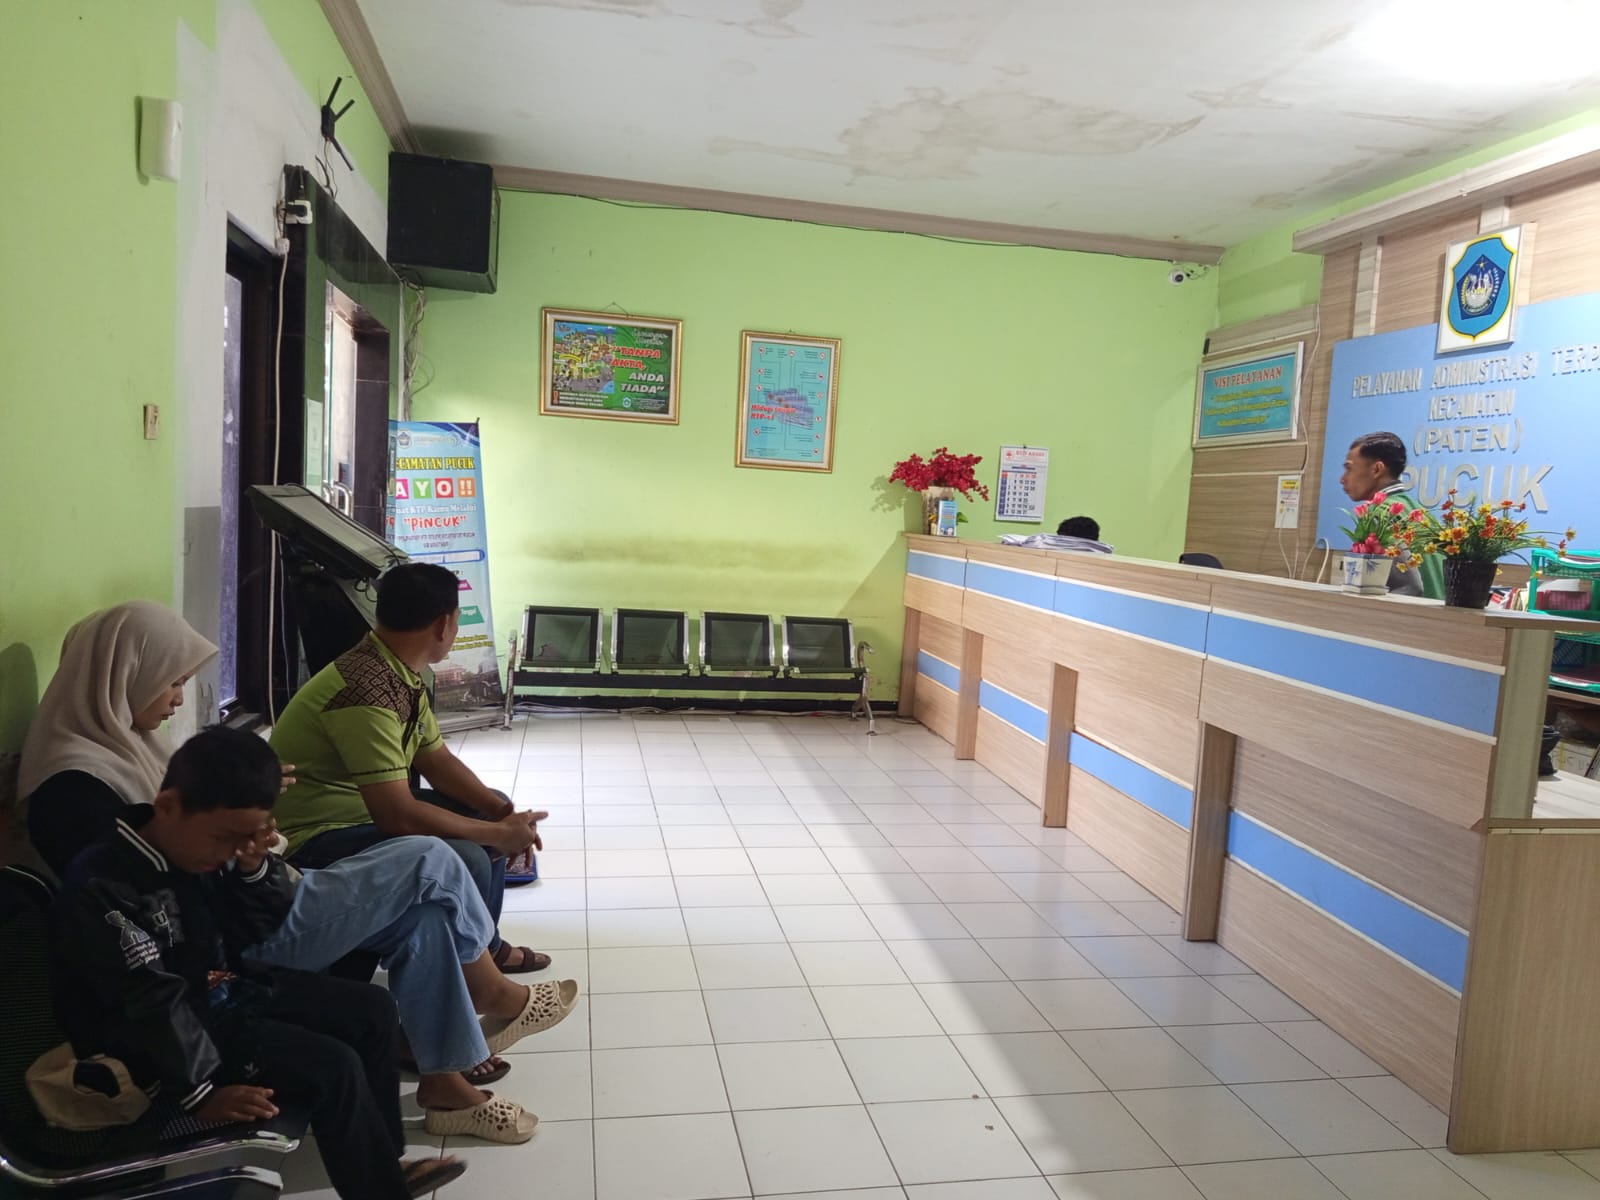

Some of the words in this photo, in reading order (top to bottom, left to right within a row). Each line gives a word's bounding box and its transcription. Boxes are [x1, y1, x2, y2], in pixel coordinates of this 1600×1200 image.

[629, 372, 665, 382] ANDA
[1231, 366, 1283, 385] PELAYANAN
[1352, 368, 1423, 398] PELAYANAN
[1430, 352, 1538, 391] ADMINISTRASI
[1428, 389, 1516, 421] KECAMATAN
[1413, 419, 1523, 456] (PATEN)
[445, 457, 476, 470] PUCUK
[1399, 463, 1553, 513] PUCUK
